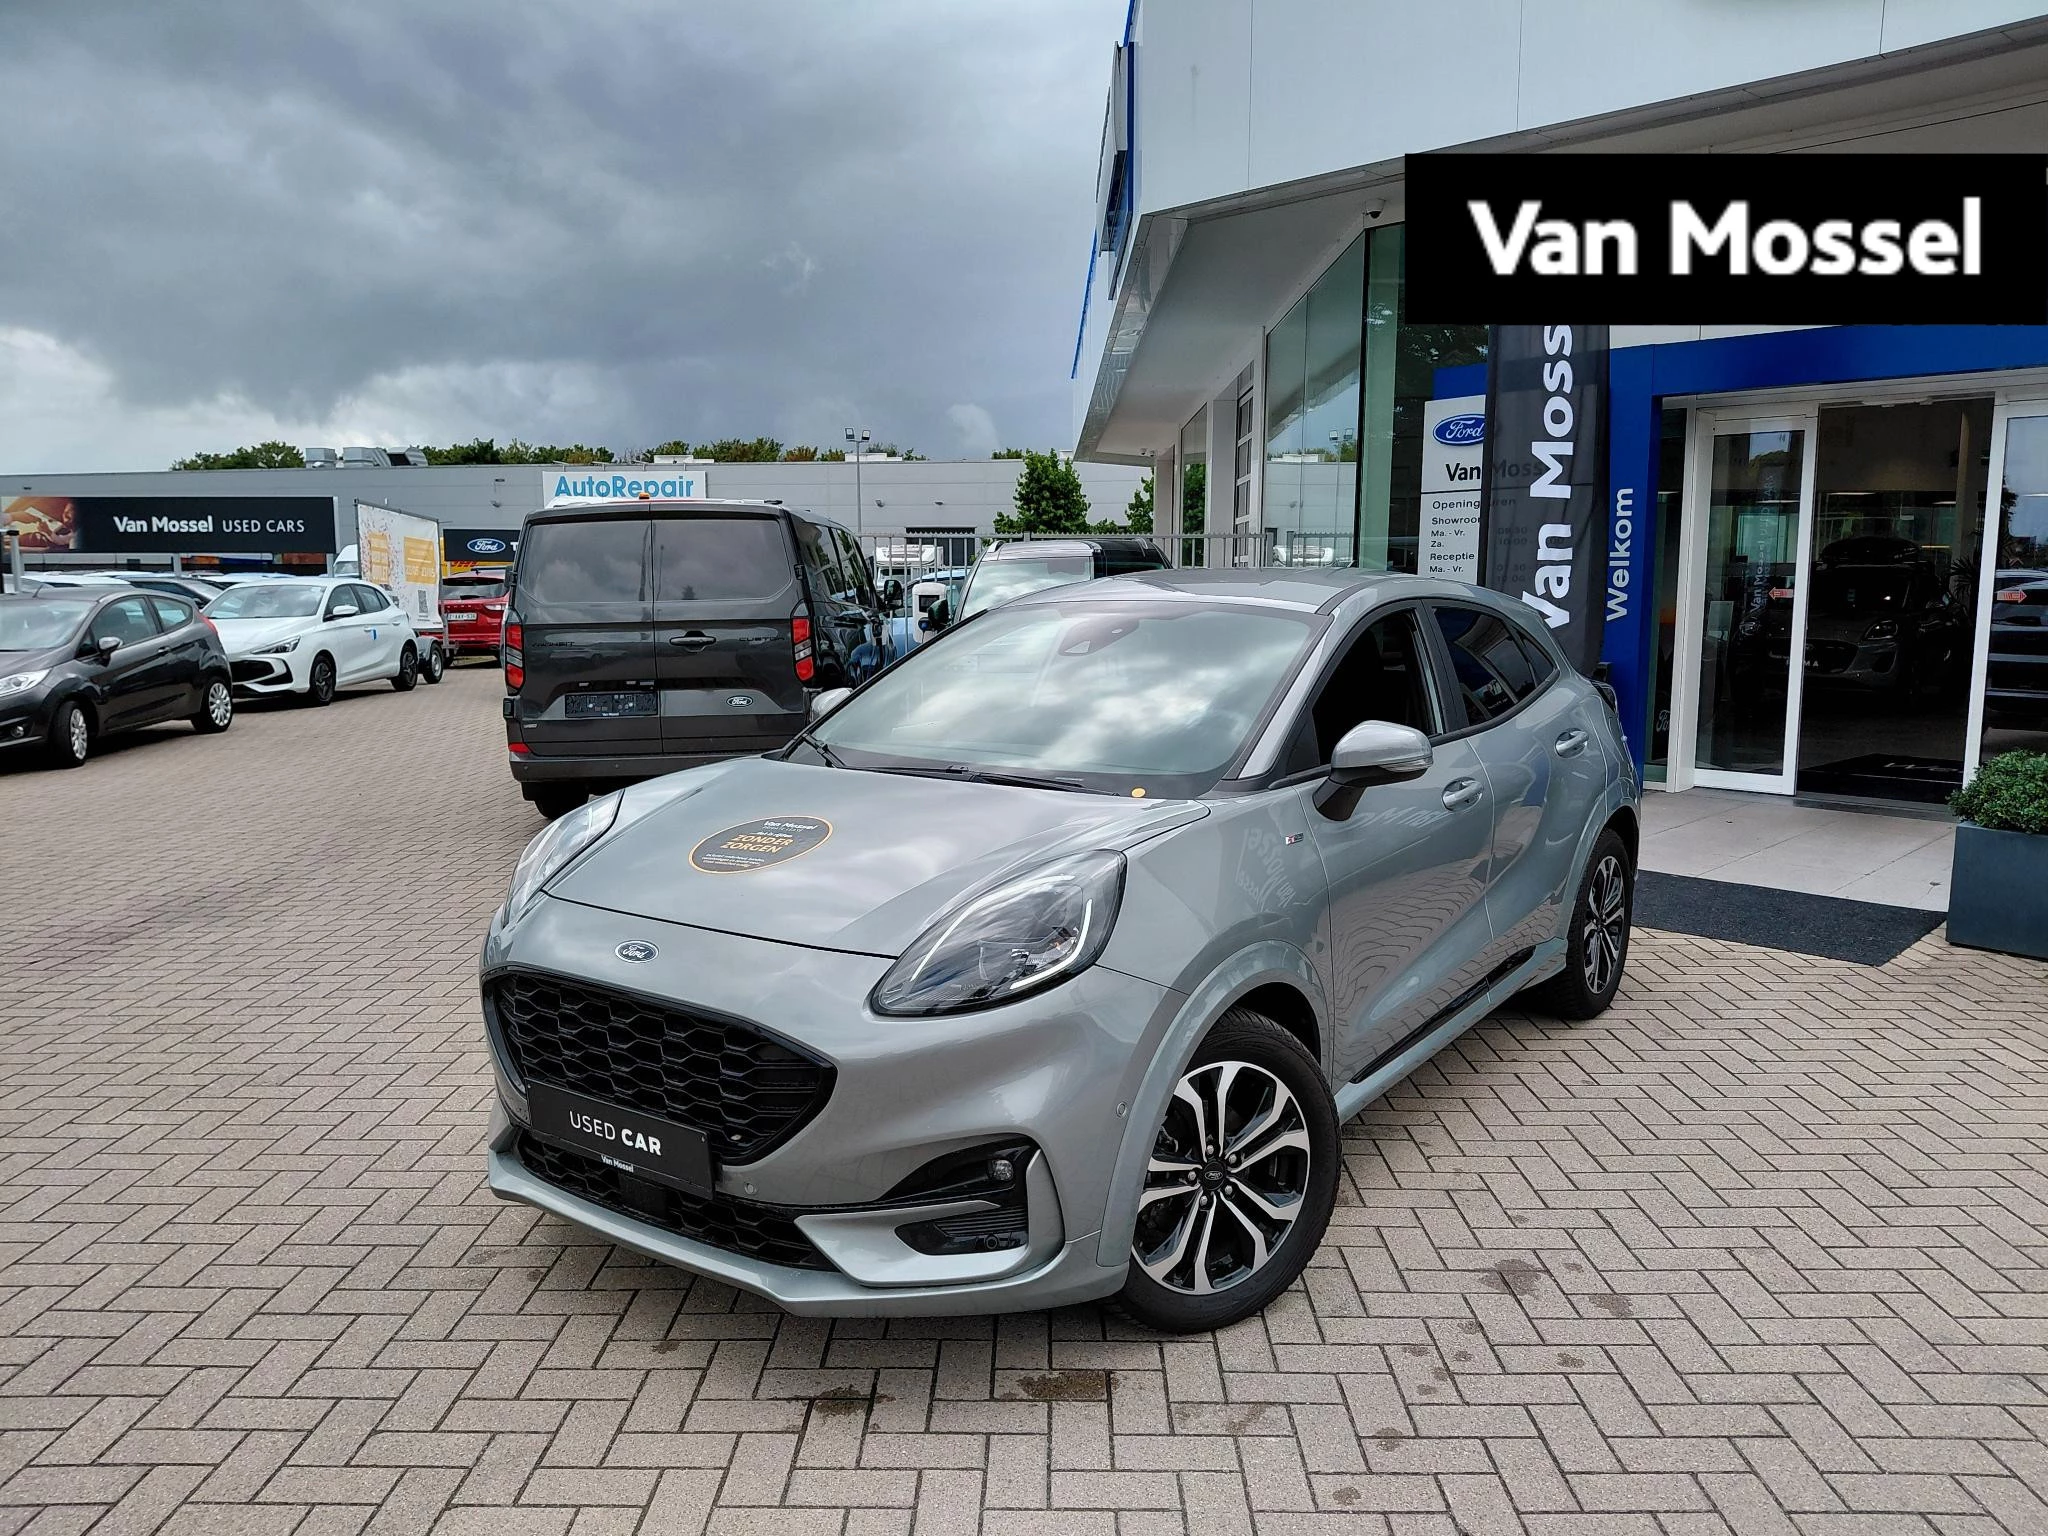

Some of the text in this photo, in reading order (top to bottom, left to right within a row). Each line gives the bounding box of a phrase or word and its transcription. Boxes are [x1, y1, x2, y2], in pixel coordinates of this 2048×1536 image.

[1529, 325, 1575, 499] Moss
[1445, 419, 1485, 439] Ford
[1445, 462, 1481, 482] Van
[555, 475, 694, 498] AutoRepair
[112, 515, 305, 533] Van Mossel USED CARS
[1431, 517, 1481, 526] Showroo
[1430, 540, 1445, 548] Za.
[1429, 552, 1475, 562] Receptie
[1606, 488, 1634, 622] Welkom
[1521, 523, 1572, 629] Van
[720, 841, 783, 853] ZORGEN
[731, 834, 794, 846] ZONDER
[569, 1110, 662, 1157] USED CAR
